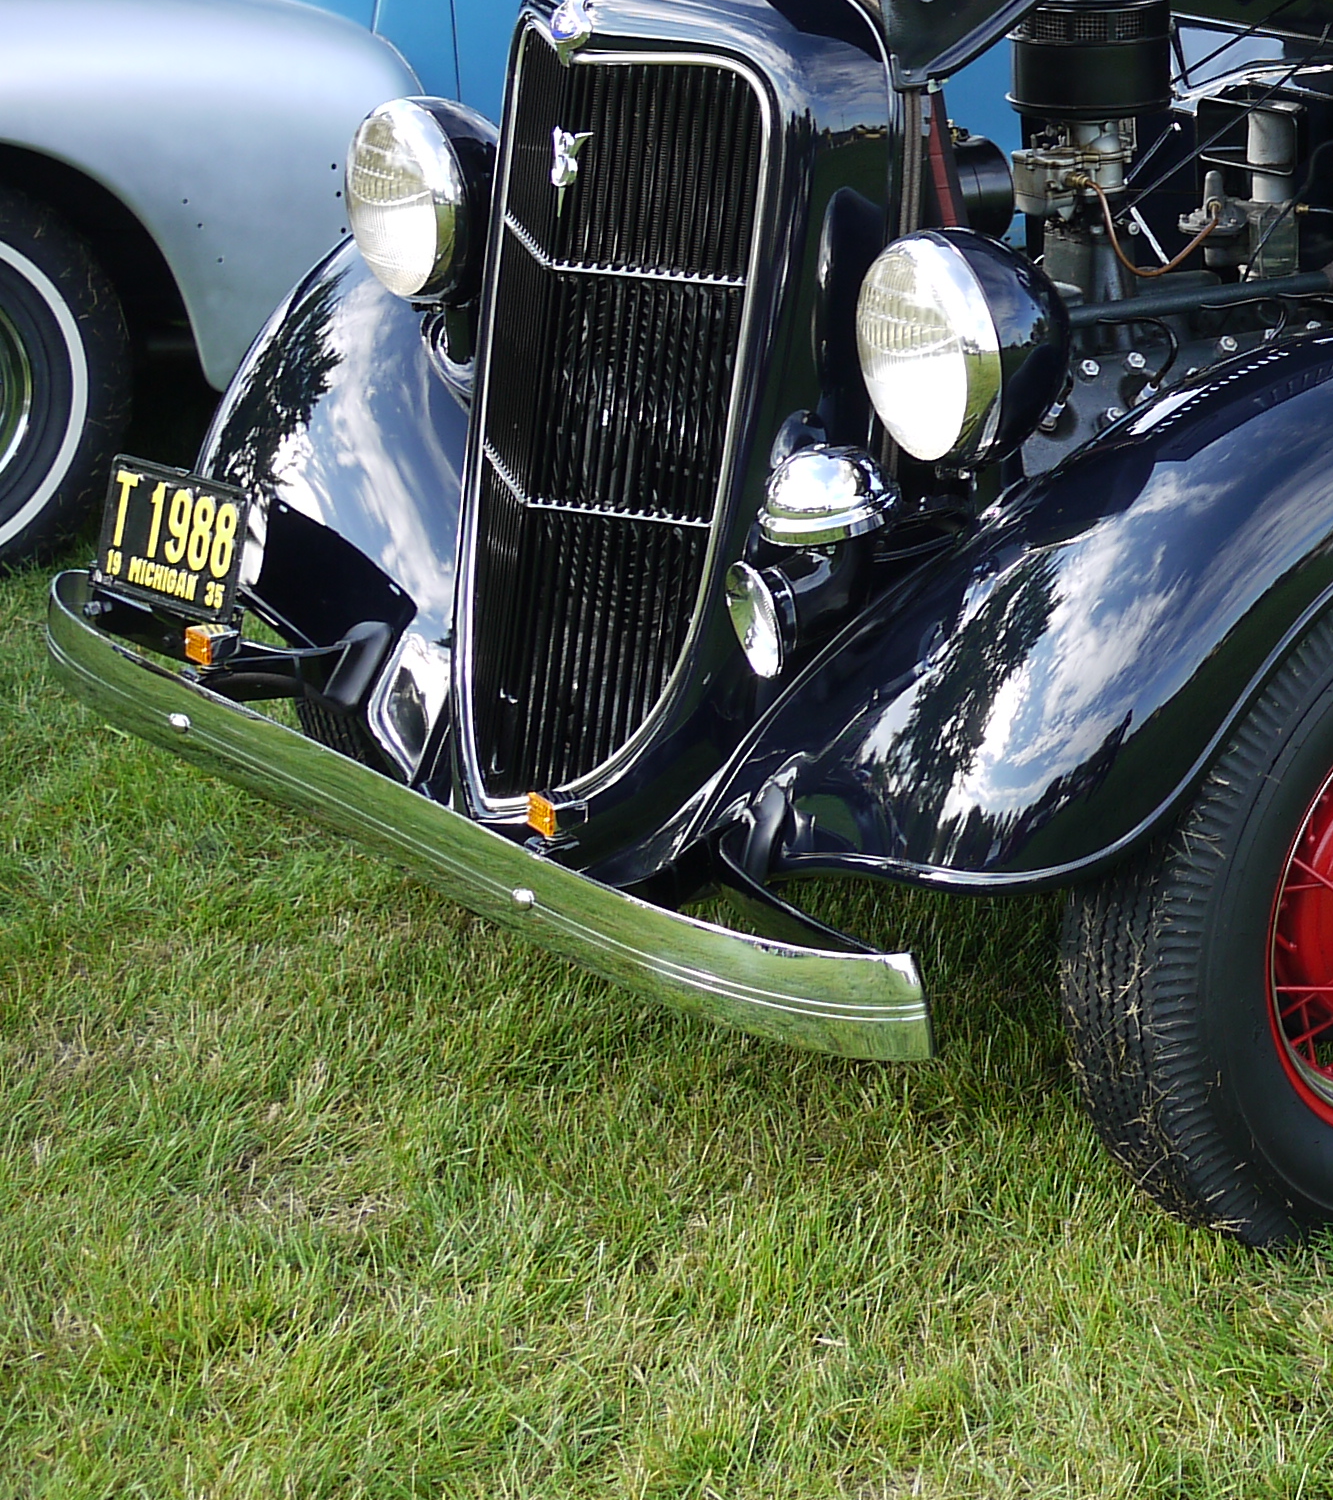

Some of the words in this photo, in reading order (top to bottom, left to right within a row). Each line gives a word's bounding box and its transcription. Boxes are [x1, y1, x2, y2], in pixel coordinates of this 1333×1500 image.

[114, 470, 139, 547] T
[147, 482, 237, 578] 1988
[106, 549, 122, 575] 19
[128, 556, 199, 601] MICHIGAN
[205, 581, 225, 609] 35
